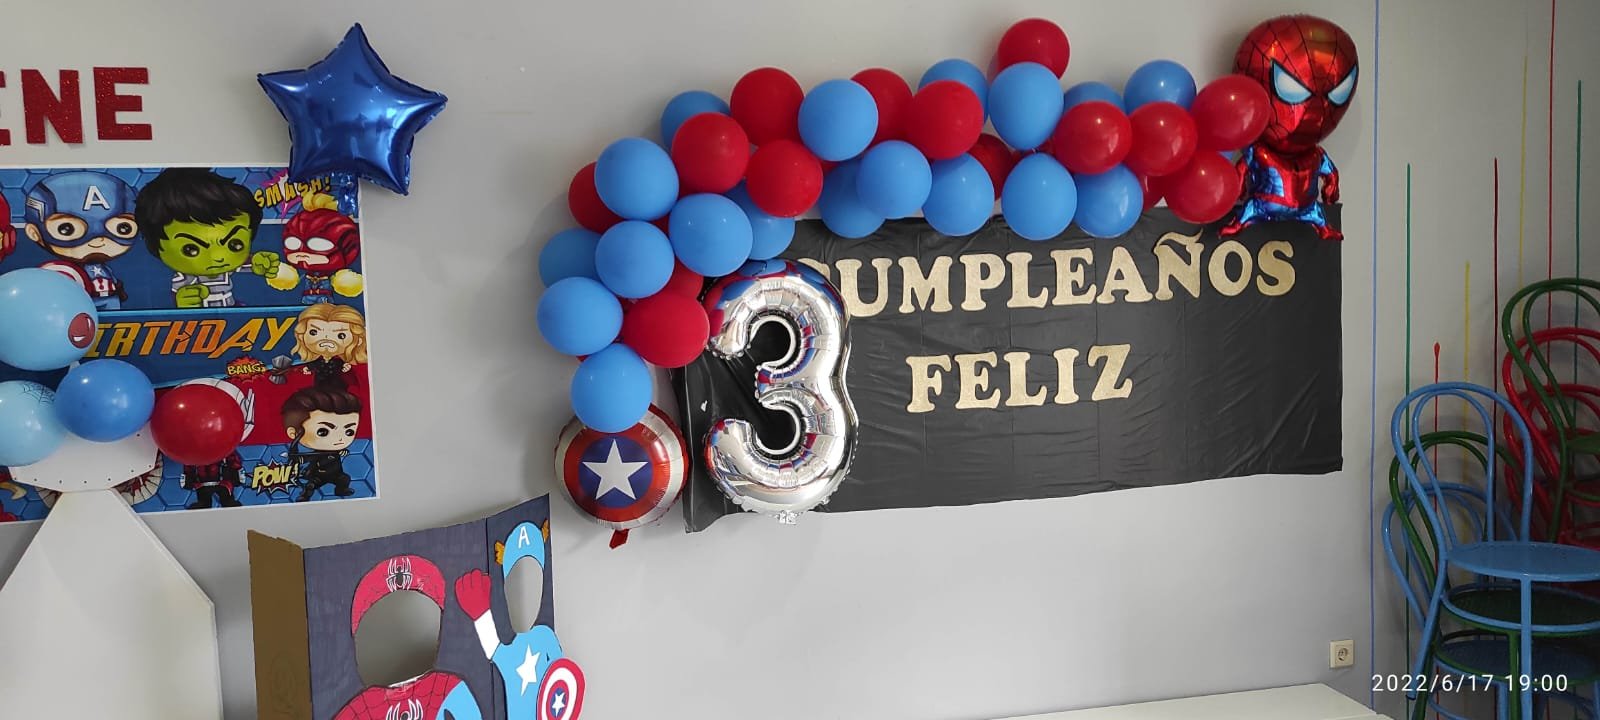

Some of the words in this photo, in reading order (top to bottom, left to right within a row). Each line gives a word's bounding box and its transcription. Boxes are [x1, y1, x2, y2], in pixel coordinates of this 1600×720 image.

[0, 67, 152, 145] NE
[82, 185, 111, 211] A
[798, 230, 1297, 320] UMPLEAÑOS
[84, 316, 298, 359] IRTHDAY
[906, 344, 1133, 413] FELIZ
[518, 525, 531, 549] A
